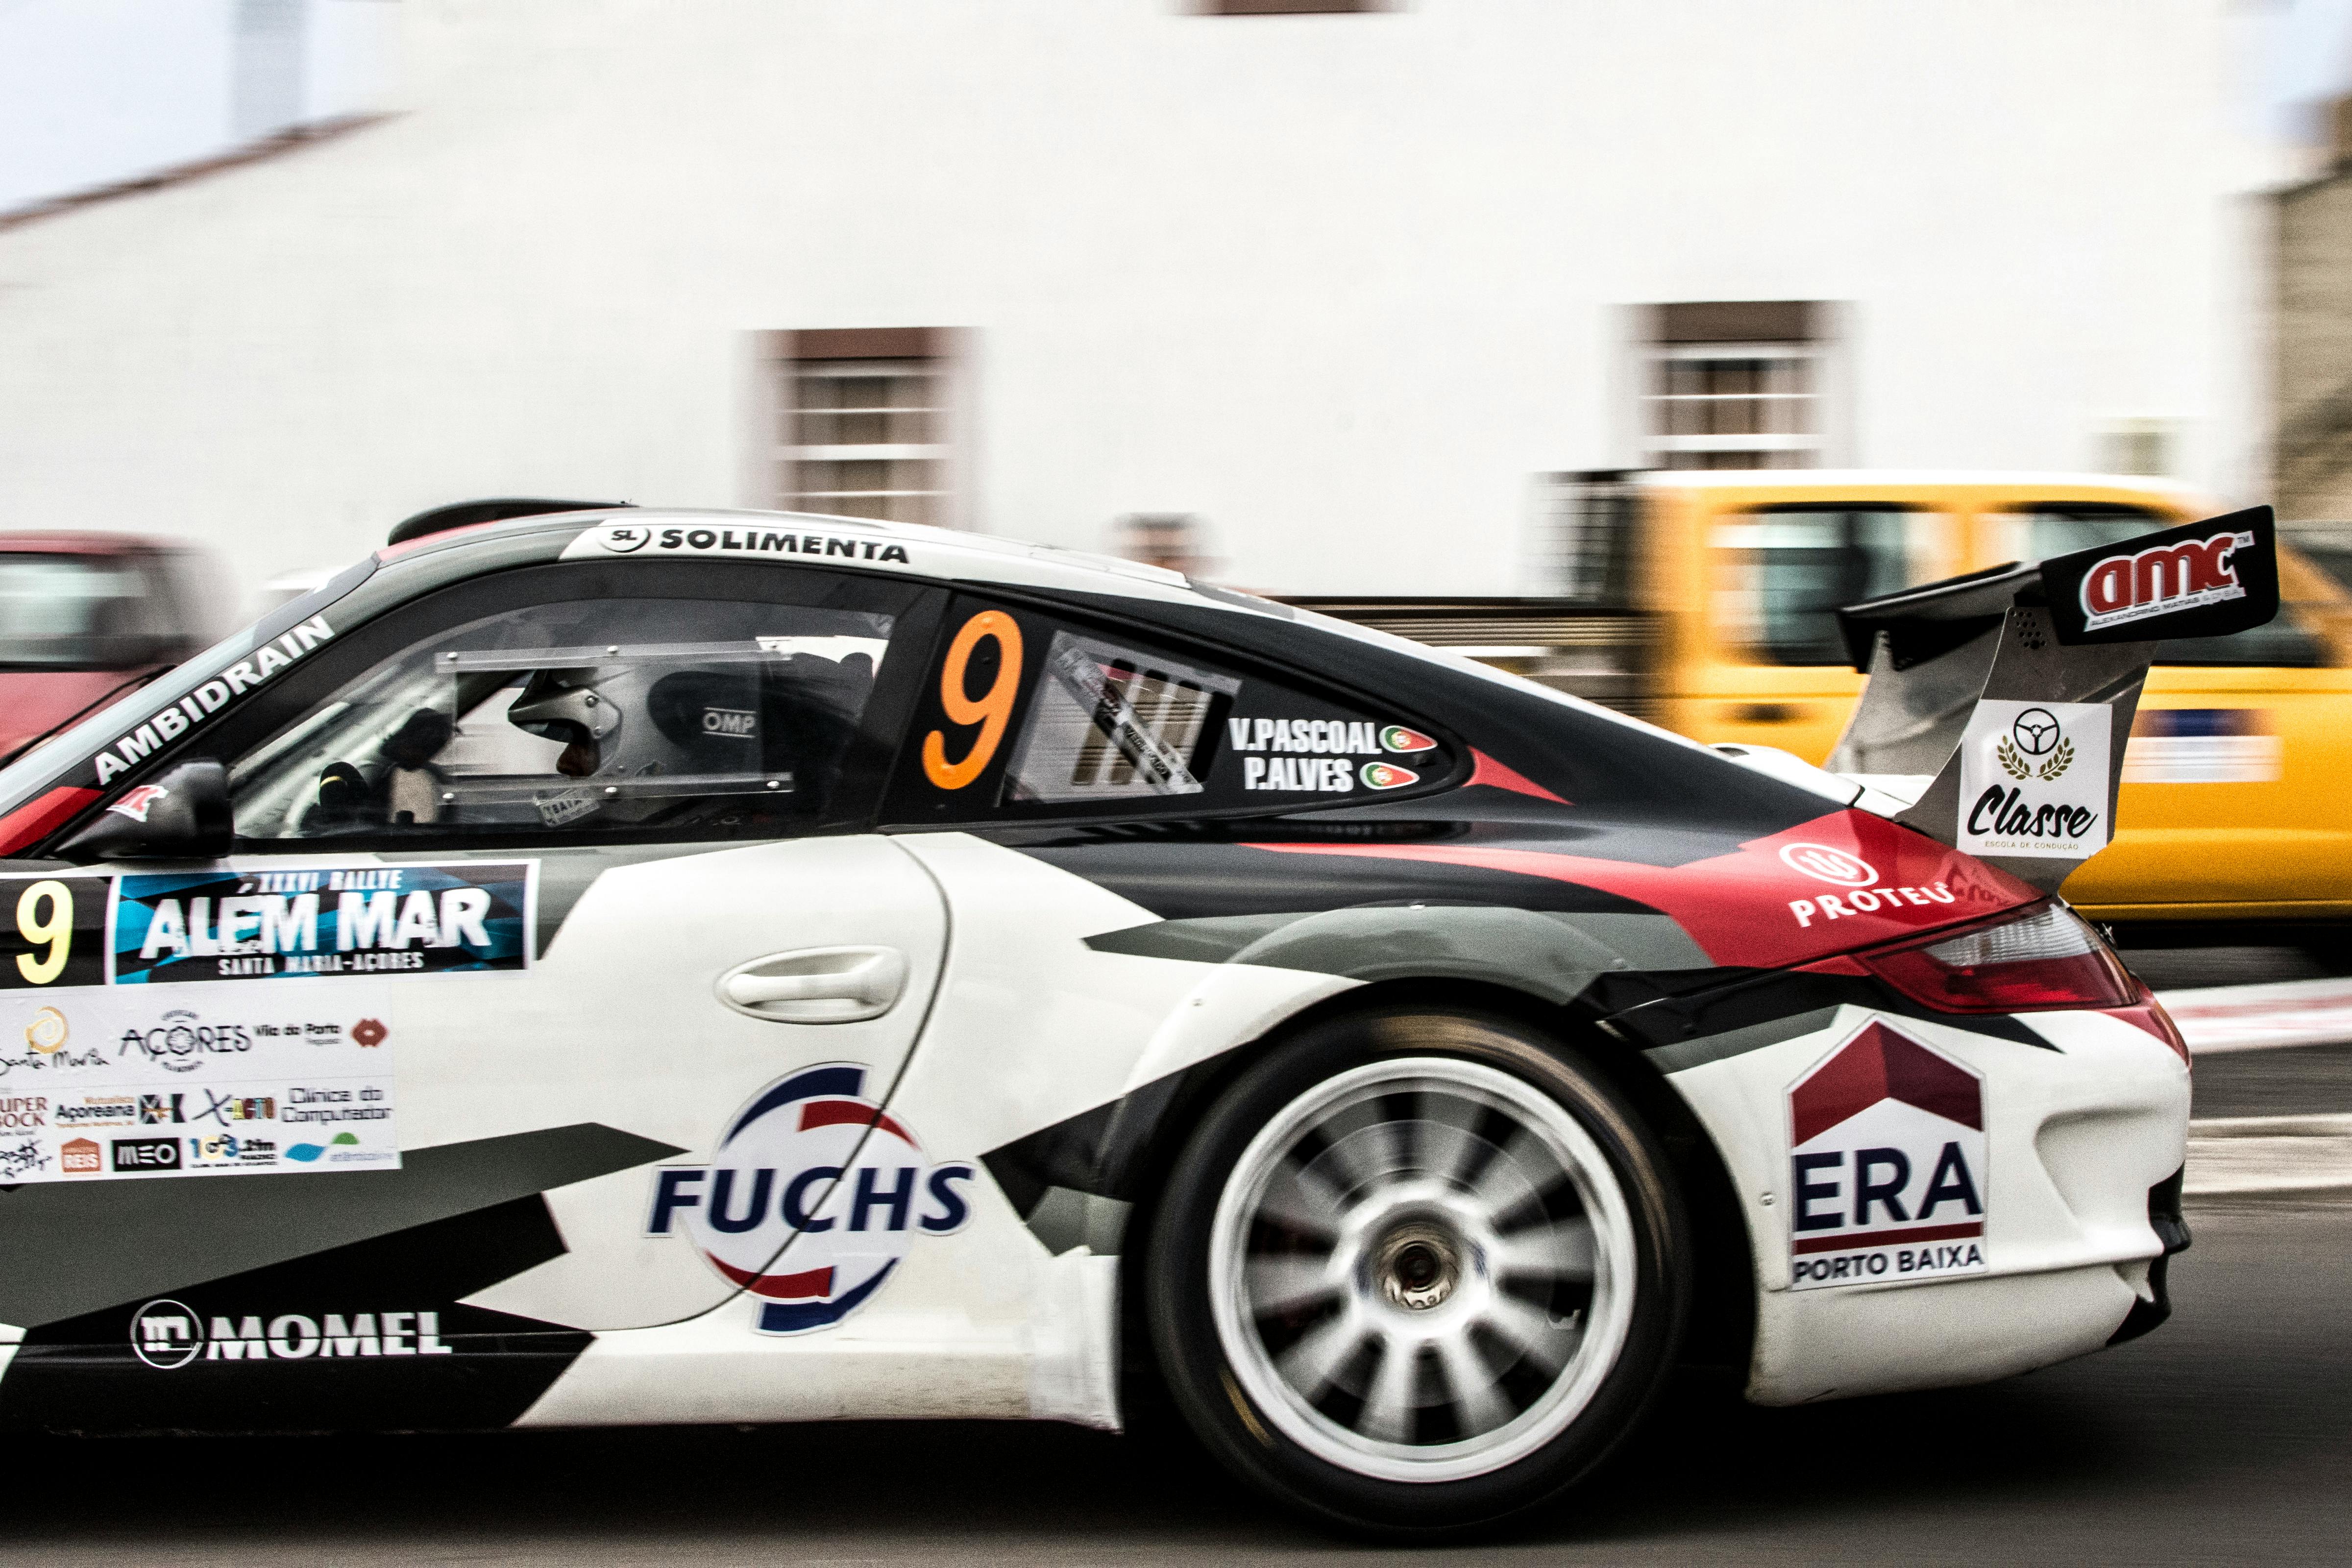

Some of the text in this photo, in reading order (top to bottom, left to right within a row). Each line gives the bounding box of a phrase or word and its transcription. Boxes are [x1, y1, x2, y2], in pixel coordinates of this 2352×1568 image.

[611, 529, 910, 564] SL SOLIMENTA
[2084, 536, 2235, 617] amc
[2091, 606, 2160, 626] ALEXANDRINO
[2162, 597, 2200, 610] MATIAS
[94, 615, 336, 786] AMBIDRAIN
[921, 610, 1024, 790] 9
[702, 712, 756, 734] OMP
[1228, 718, 1382, 755] V.PASCOAL
[1244, 757, 1354, 793] P.ALVES
[1967, 784, 2098, 838] Classe
[328, 870, 404, 891] RALLYE
[16, 880, 74, 984] 9
[138, 882, 493, 959] ALÉM MAR
[218, 956, 276, 976] SANTA
[118, 1025, 253, 1062] AÇORES
[253, 1024, 280, 1036] Vila
[304, 1022, 342, 1035] Porto
[0, 1097, 48, 1113] UPER
[289, 1085, 384, 1103] Clínica do
[55, 1104, 135, 1123] Açoreana
[281, 1104, 393, 1126] Computador
[63, 1153, 99, 1169] REIS
[117, 1143, 177, 1165] MEO
[647, 1166, 976, 1234] FUCHS
[1791, 1141, 1984, 1232] ERA
[1792, 1244, 1985, 1284] PORTO BAIXA
[206, 1311, 453, 1360] MOMEL
